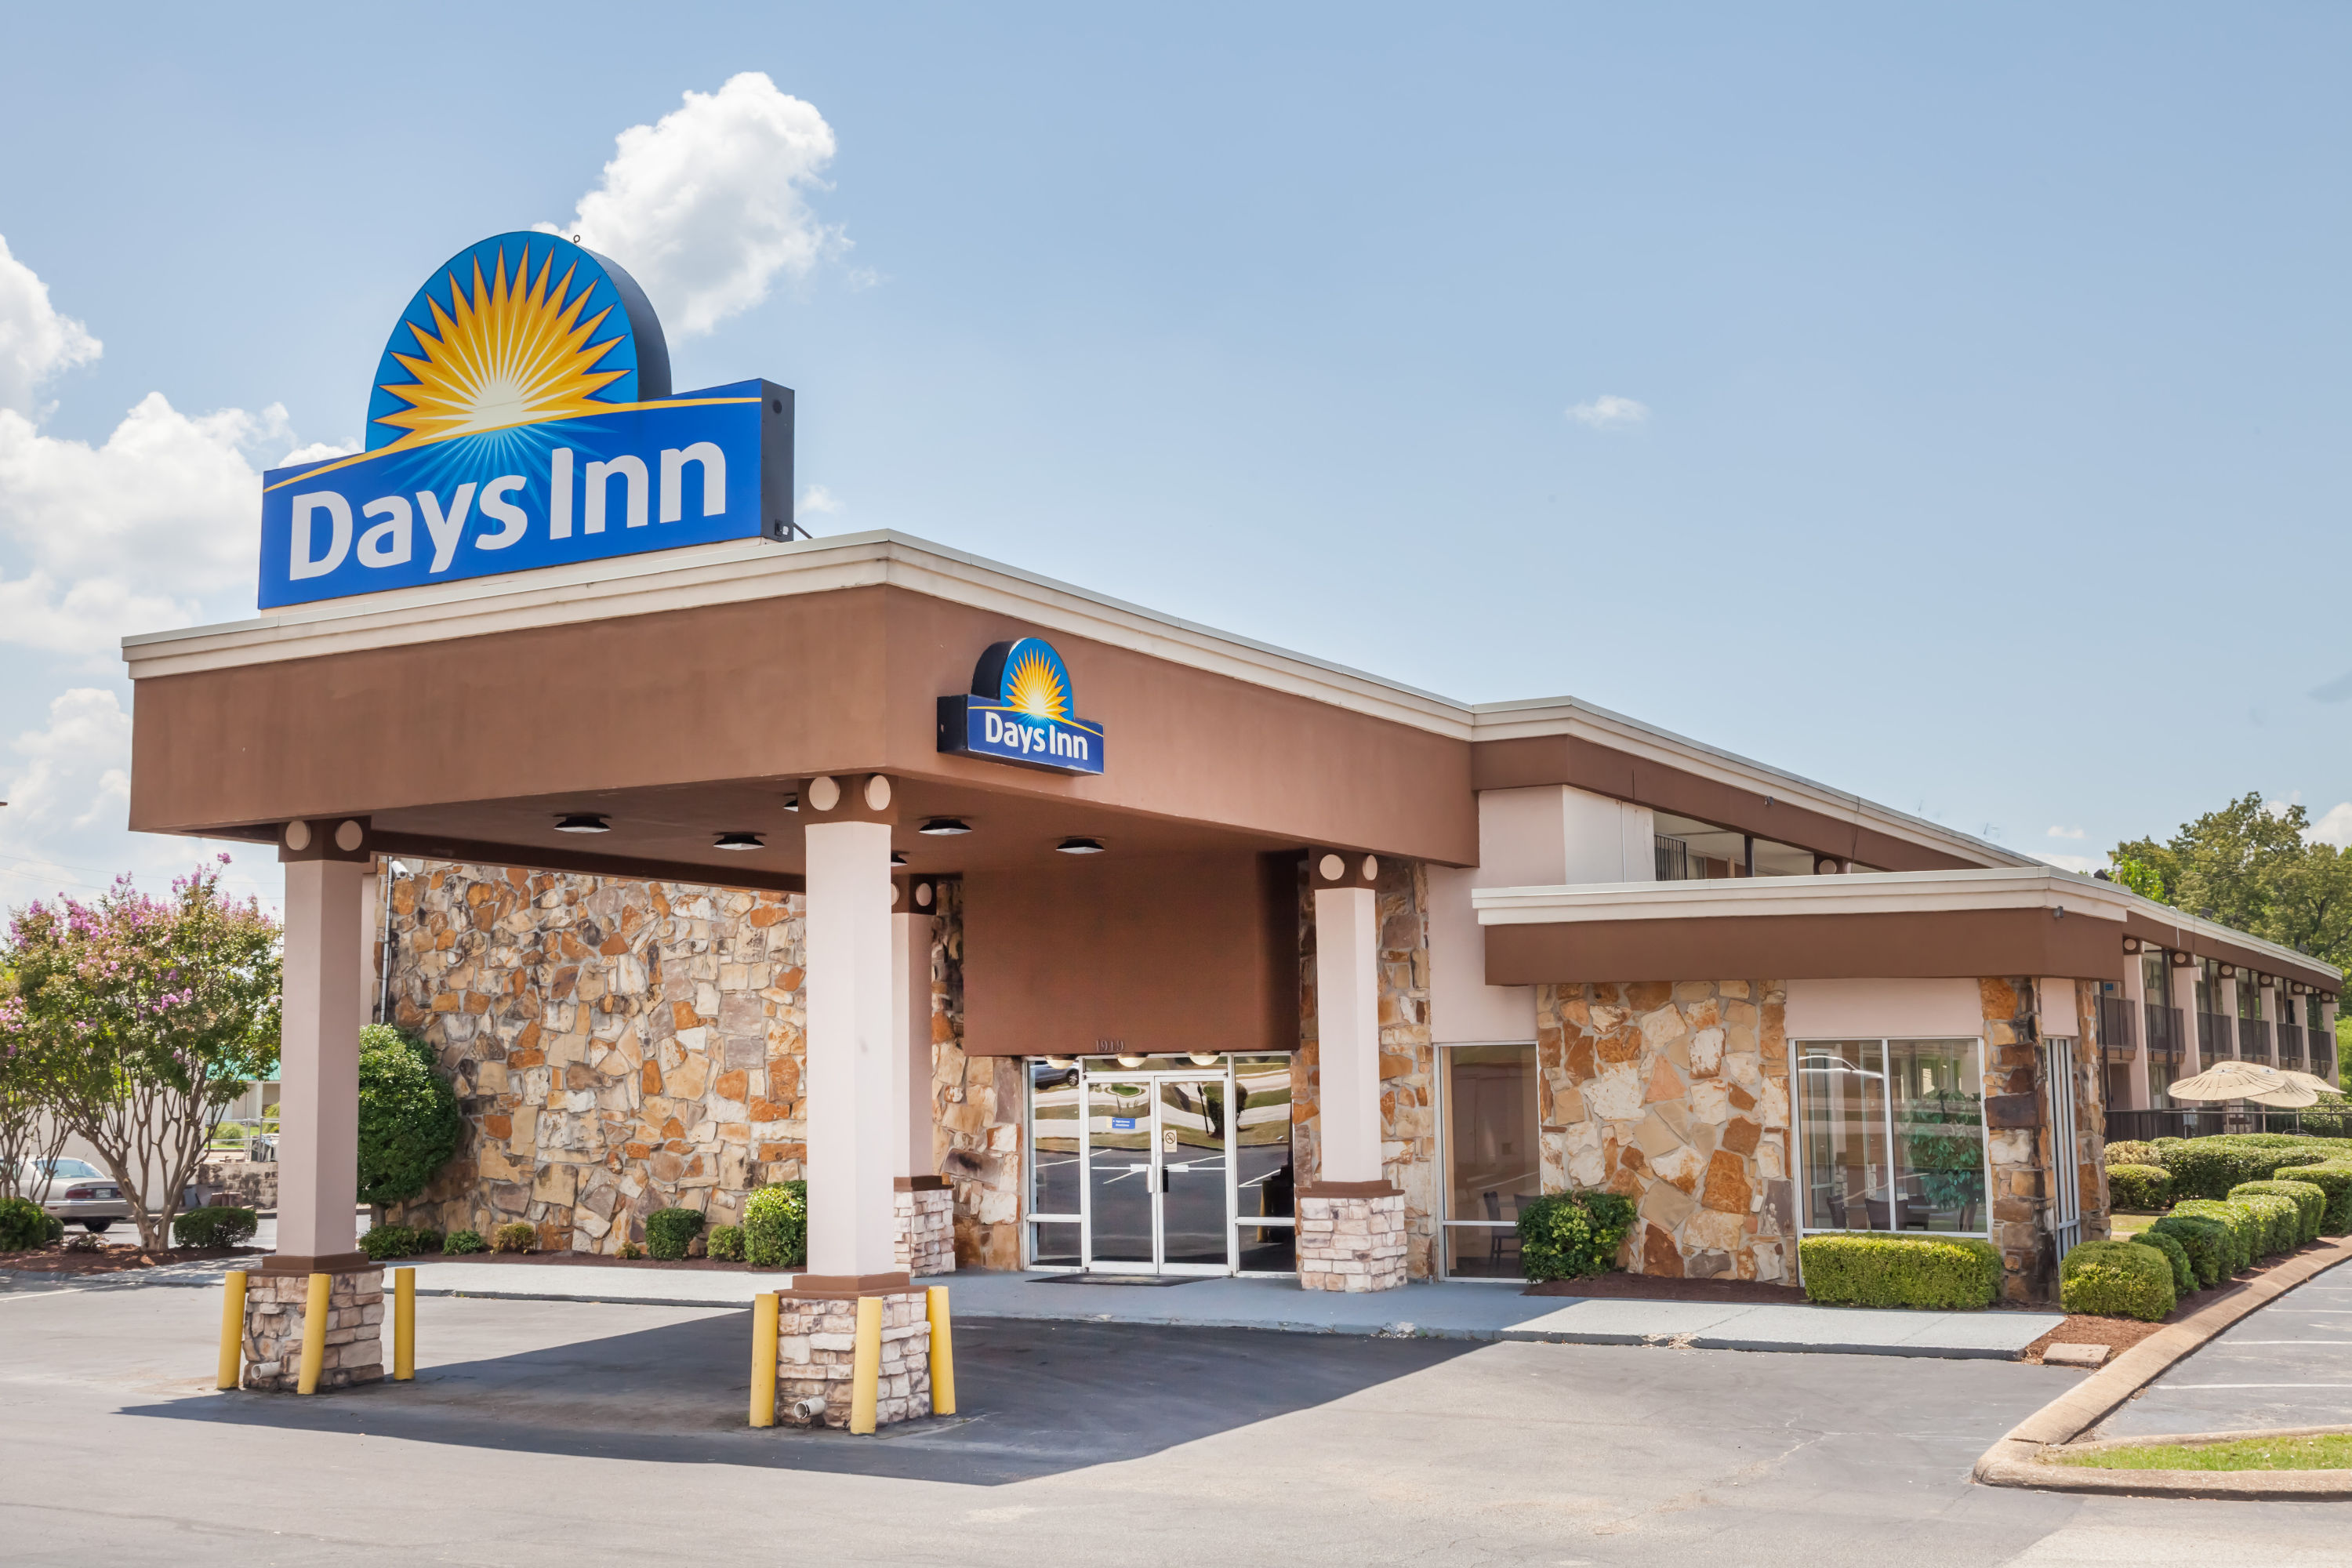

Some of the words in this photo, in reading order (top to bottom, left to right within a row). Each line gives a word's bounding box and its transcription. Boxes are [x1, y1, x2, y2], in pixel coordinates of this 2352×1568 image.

[290, 476, 528, 581] Days
[550, 442, 726, 539] Inn
[985, 711, 1045, 754] Days
[1049, 724, 1088, 760] Inn
